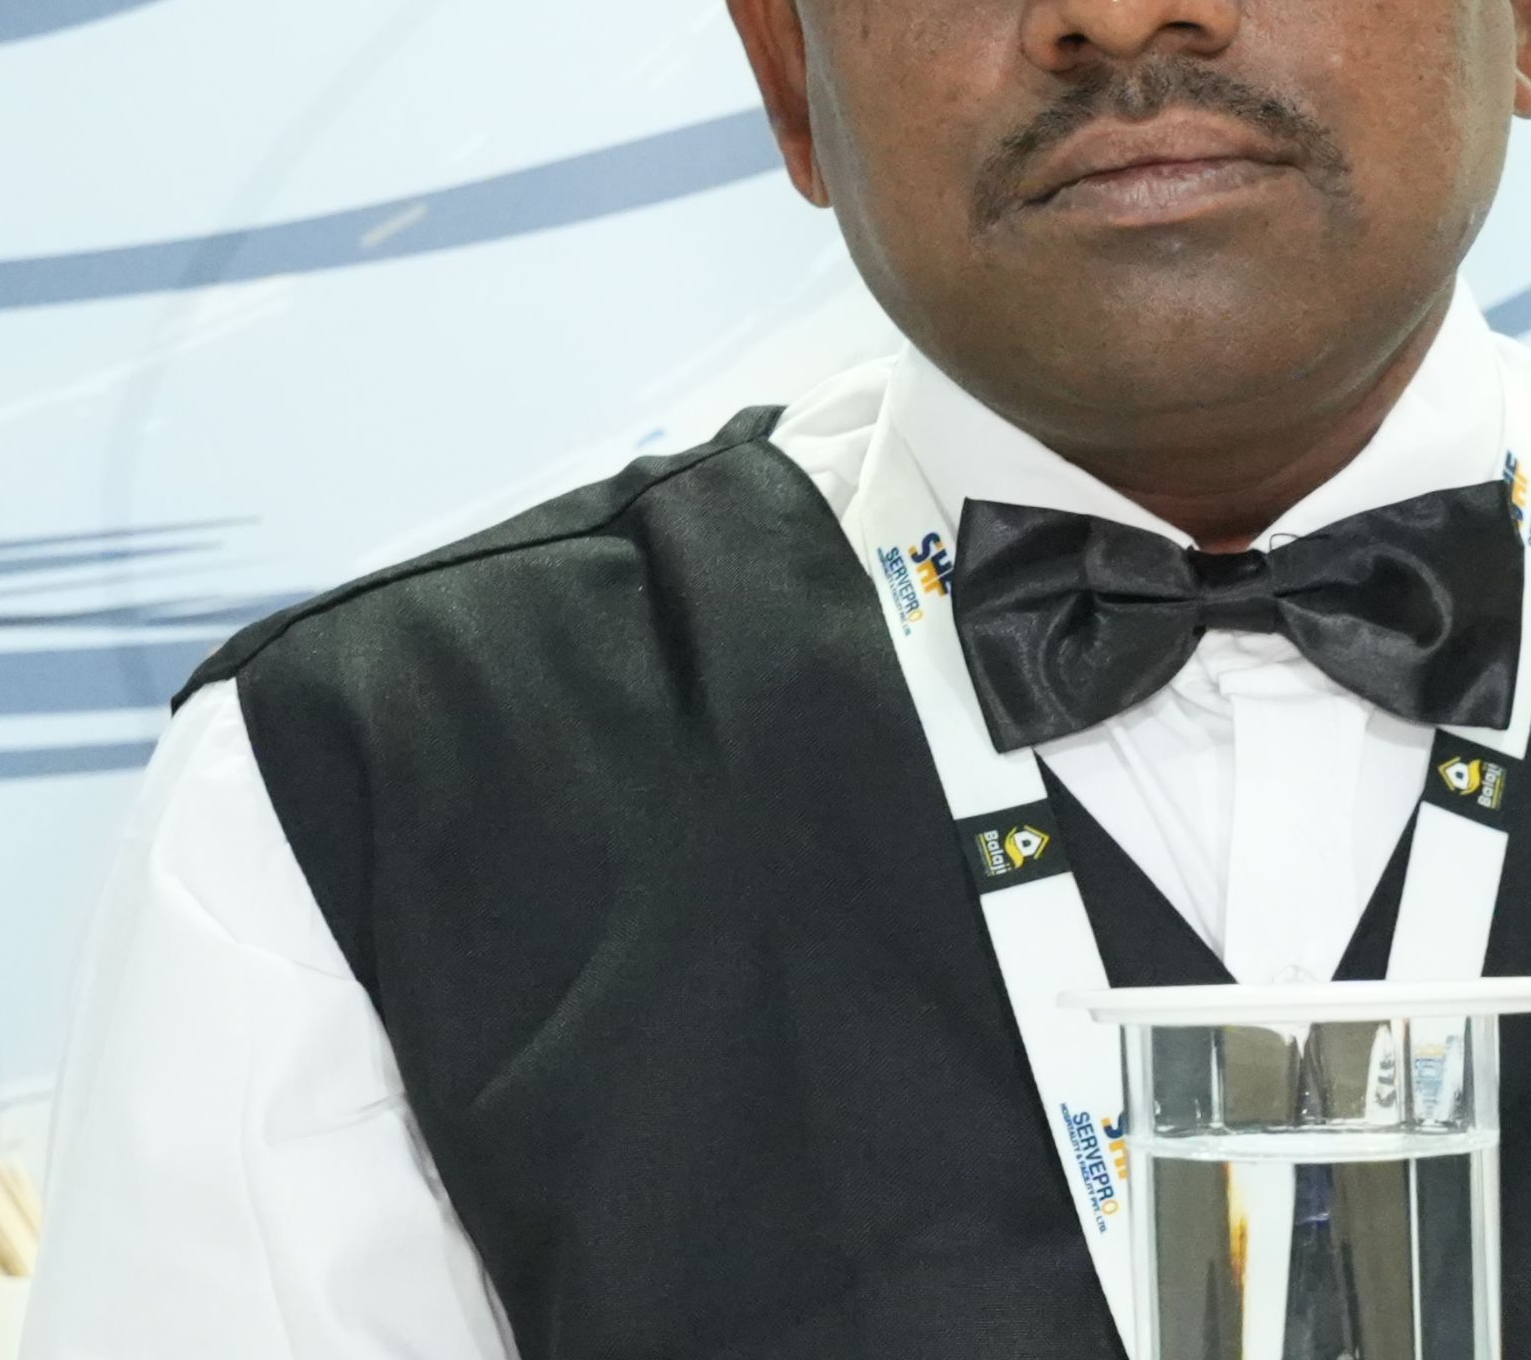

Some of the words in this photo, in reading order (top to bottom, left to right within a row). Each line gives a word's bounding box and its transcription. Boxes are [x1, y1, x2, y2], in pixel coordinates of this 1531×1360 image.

[885, 545, 924, 624] SERVEPRO
[983, 829, 1012, 875] Balaji
[1072, 1111, 1119, 1215] SERVEPRO
